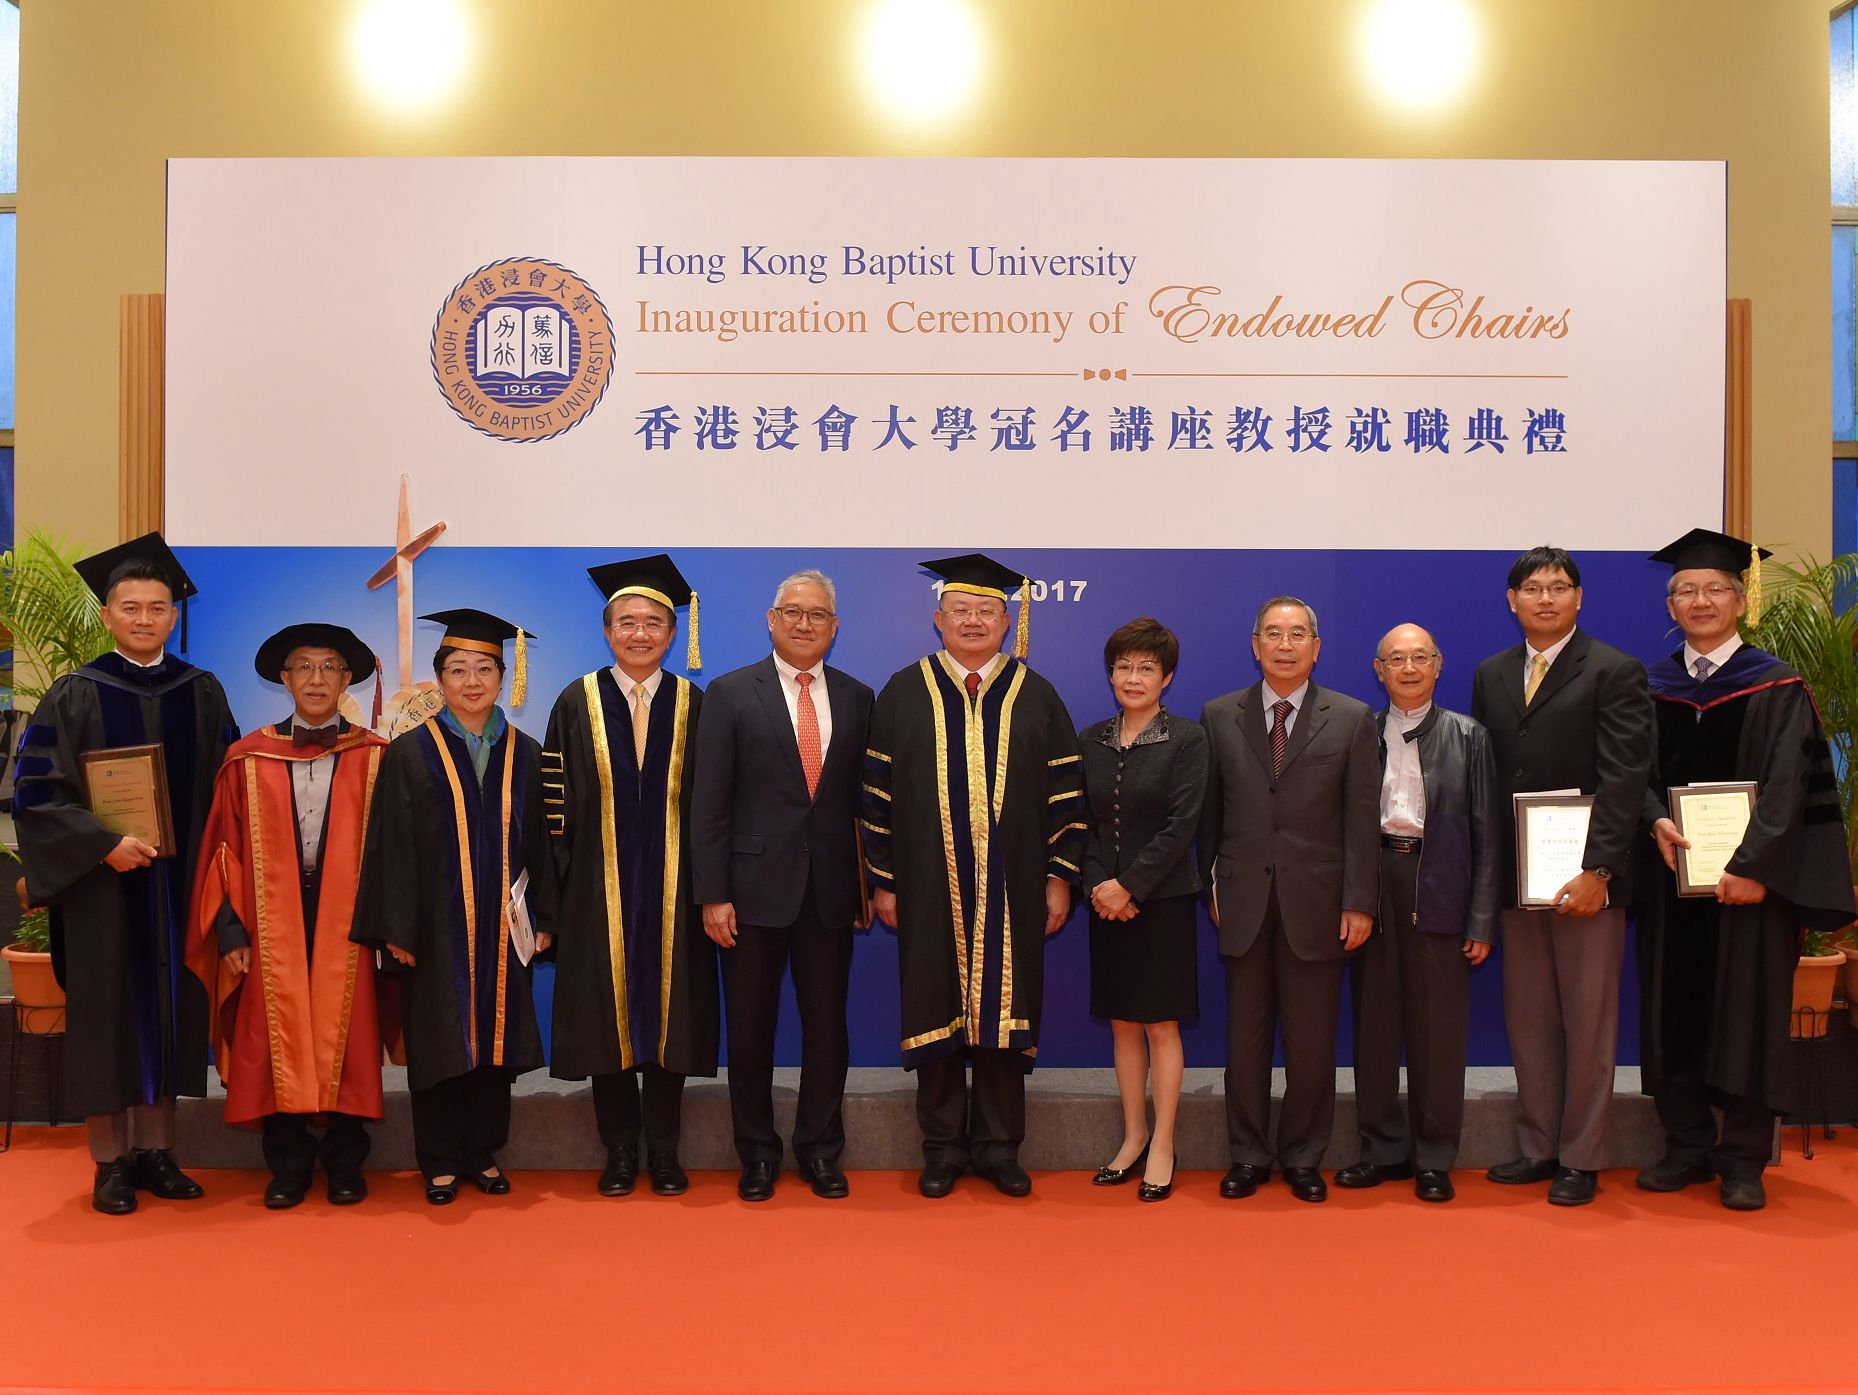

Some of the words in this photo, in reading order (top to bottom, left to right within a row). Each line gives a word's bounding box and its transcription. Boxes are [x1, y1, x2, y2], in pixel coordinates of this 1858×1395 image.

[636, 246, 725, 283] Hong
[741, 246, 827, 283] Kong
[842, 245, 955, 284] Baptist
[968, 245, 1136, 285] University
[456, 268, 593, 315] 香港浸會大學
[636, 300, 867, 342] Inauguration
[887, 301, 1073, 343] Ceremony
[1088, 302, 1128, 334] of
[1149, 286, 1393, 343] Endowed
[1401, 279, 1570, 340] Chairs
[442, 330, 460, 376] HONG
[452, 379, 488, 418] KONG
[489, 411, 553, 431] BAPTIST
[557, 330, 604, 419] UNIVERSITY
[504, 385, 542, 395] 1956
[634, 404, 1568, 455] 香港浸會大學冠名講座教授就職典禮
